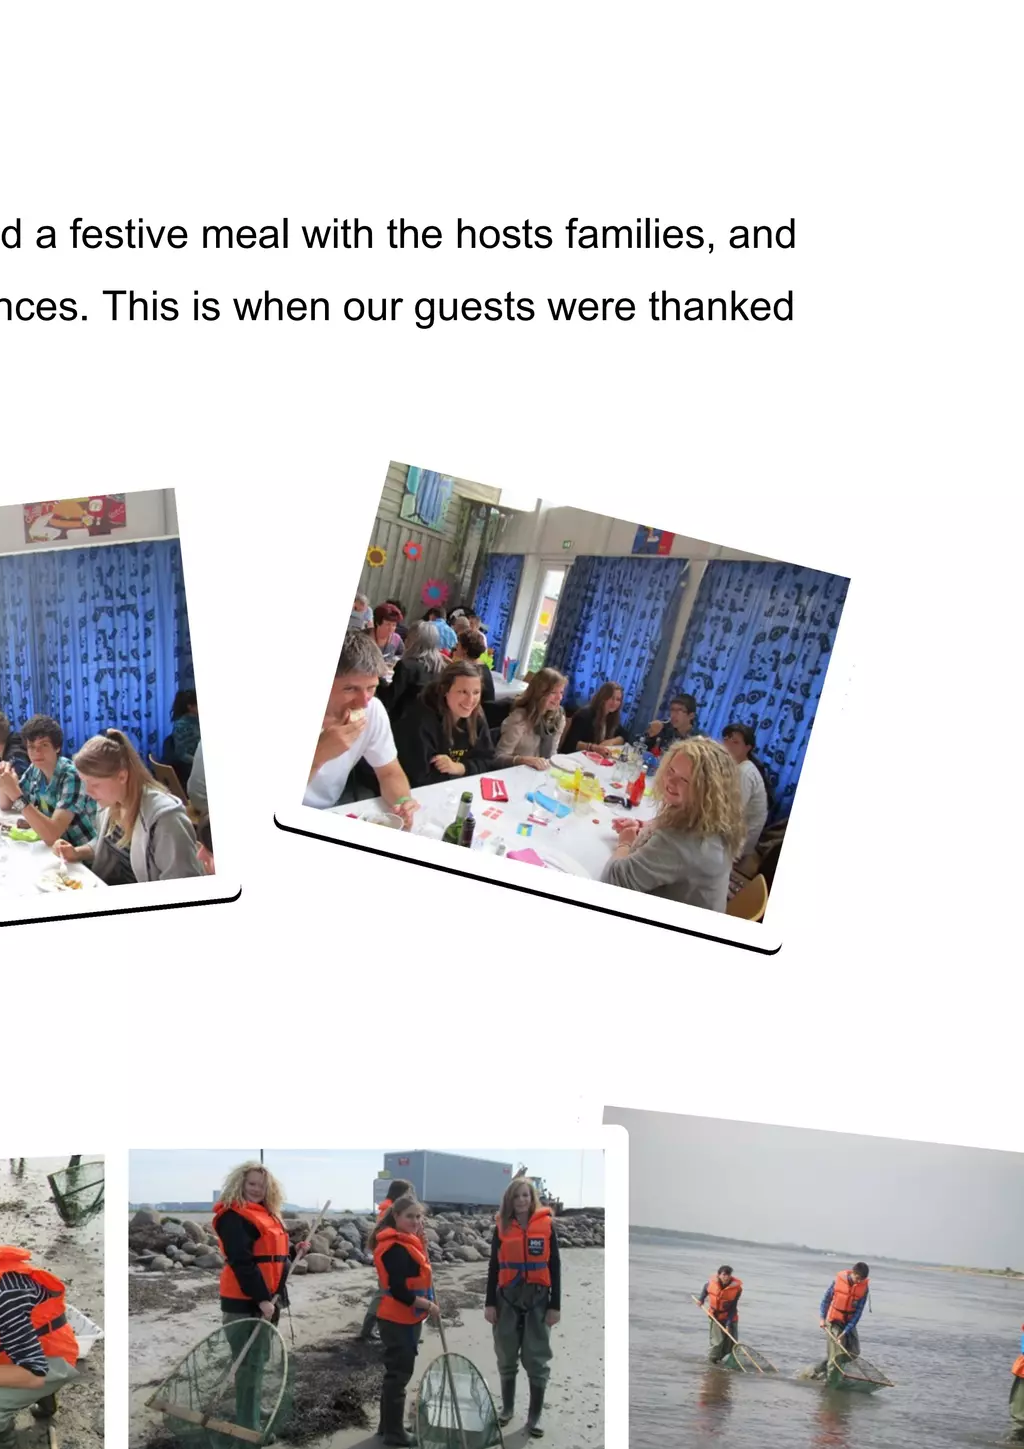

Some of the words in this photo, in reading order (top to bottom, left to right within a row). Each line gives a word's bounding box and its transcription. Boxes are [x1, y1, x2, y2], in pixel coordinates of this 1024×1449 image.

[36, 226, 56, 249] a
[70, 218, 187, 249] festive
[203, 218, 288, 249] meal
[302, 218, 372, 248] with
[387, 218, 442, 249] the
[458, 218, 552, 249] hosts
[565, 218, 713, 254] families,
[730, 218, 795, 249] and
[103, 290, 179, 321] This
[194, 290, 220, 321] is
[233, 290, 329, 321] when
[344, 298, 403, 321] our
[415, 291, 535, 329] guests
[547, 298, 635, 321] were
[649, 290, 793, 321] thanked
